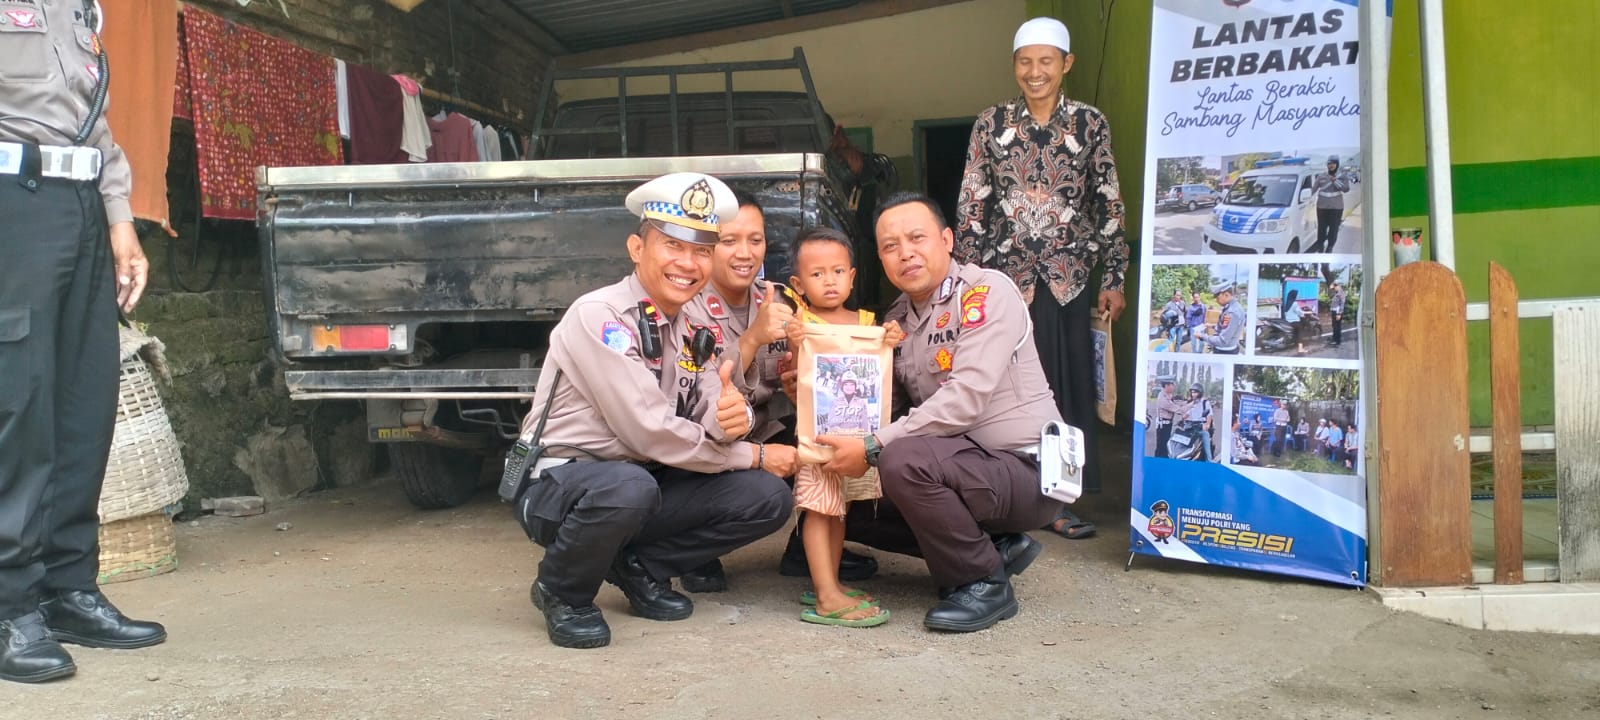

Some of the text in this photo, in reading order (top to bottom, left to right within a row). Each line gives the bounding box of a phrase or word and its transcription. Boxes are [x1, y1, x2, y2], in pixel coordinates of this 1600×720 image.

[1192, 8, 1344, 49] LANTAS
[1170, 41, 1360, 82] BERBAKAT
[1194, 76, 1336, 110] Lantas Beraksi
[1161, 97, 1360, 137] Sambang Masyaraka
[768, 340, 788, 354] POL
[927, 327, 960, 346] POLRI
[834, 405, 863, 417] STOP
[1182, 508, 1233, 520] TRANSFORMASI
[1182, 516, 1251, 531] MENUJU POLRI YANG
[1182, 525, 1294, 552] PRESISI
